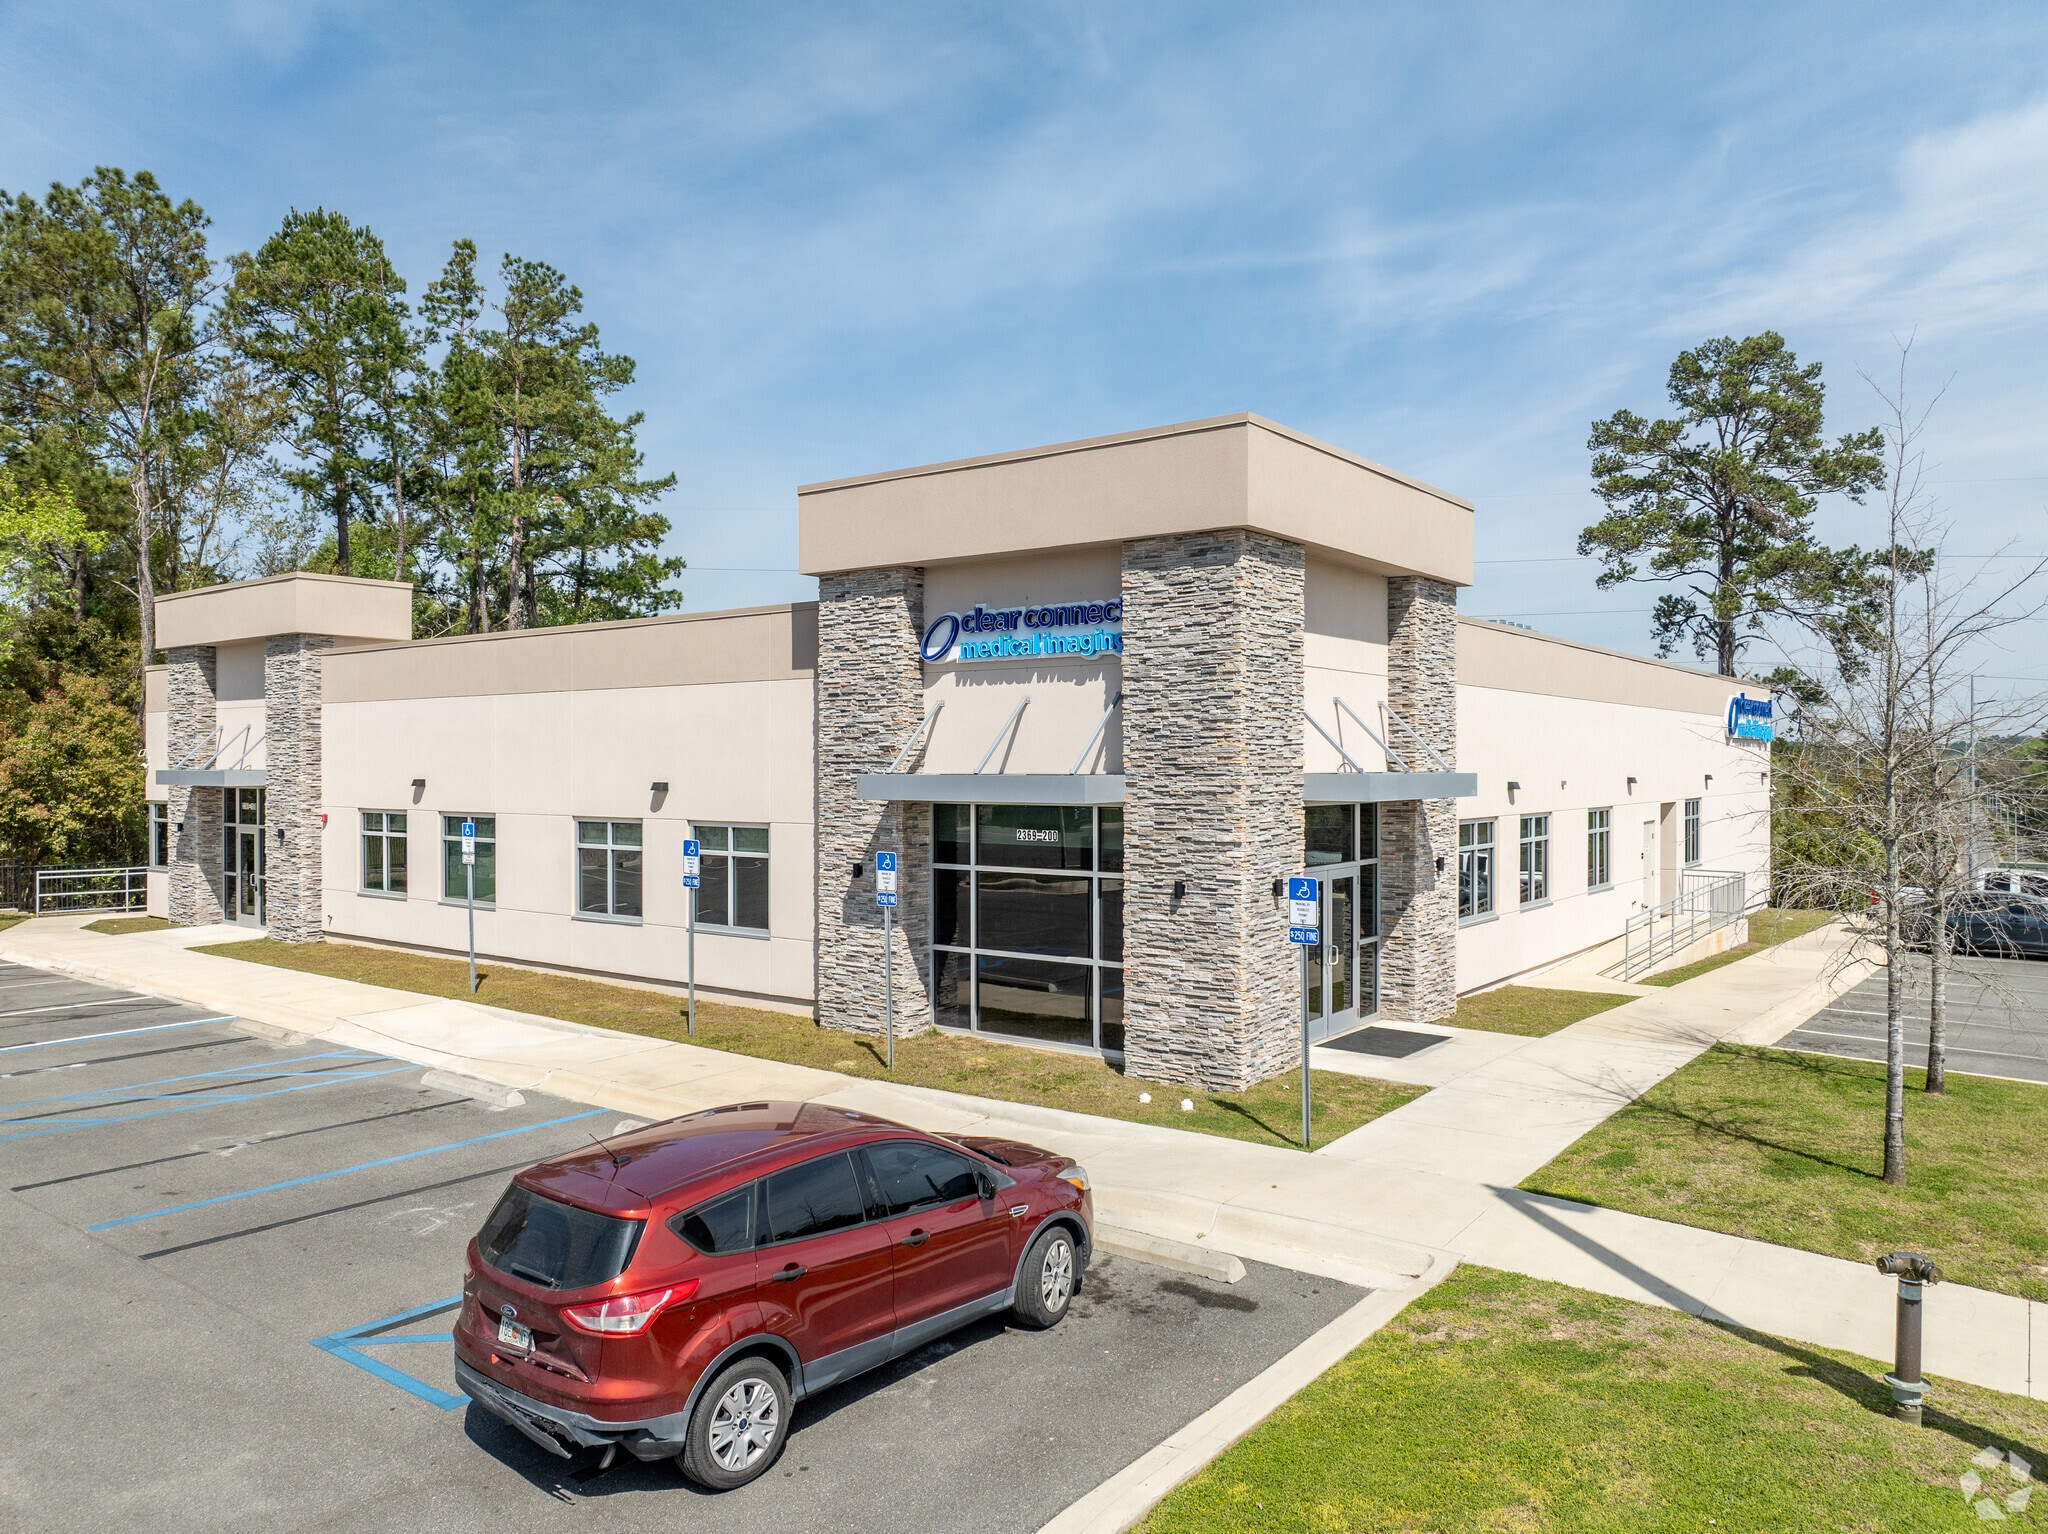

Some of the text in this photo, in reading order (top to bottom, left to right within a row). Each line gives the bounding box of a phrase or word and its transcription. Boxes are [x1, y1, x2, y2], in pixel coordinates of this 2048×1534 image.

[961, 596, 1123, 634] clear connec
[960, 632, 1041, 659] medical
[1017, 829, 1058, 841] 2369-200
[1306, 931, 1318, 942] FINE
